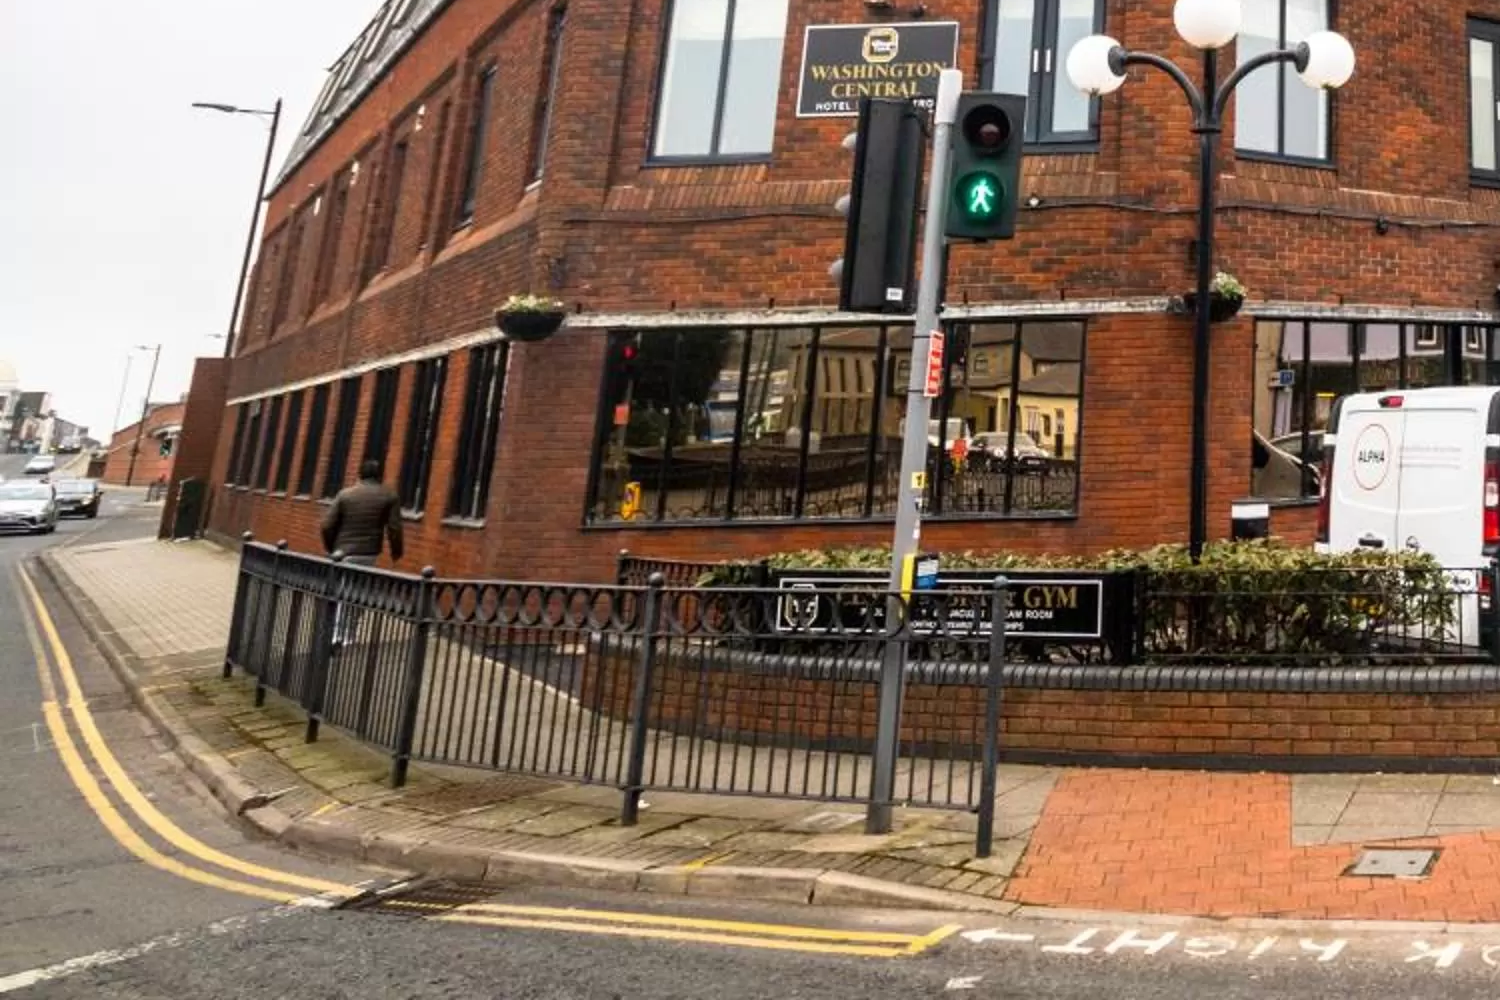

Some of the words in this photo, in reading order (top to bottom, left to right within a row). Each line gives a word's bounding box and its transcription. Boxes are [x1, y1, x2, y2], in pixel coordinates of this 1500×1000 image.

[811, 61, 947, 81] WASHINGTON
[831, 81, 921, 98] CENTRAL
[815, 101, 851, 111] HOTEL
[1358, 451, 1385, 463] ALPHA
[1023, 585, 1078, 609] GYM
[1025, 610, 1053, 619] ROOM
